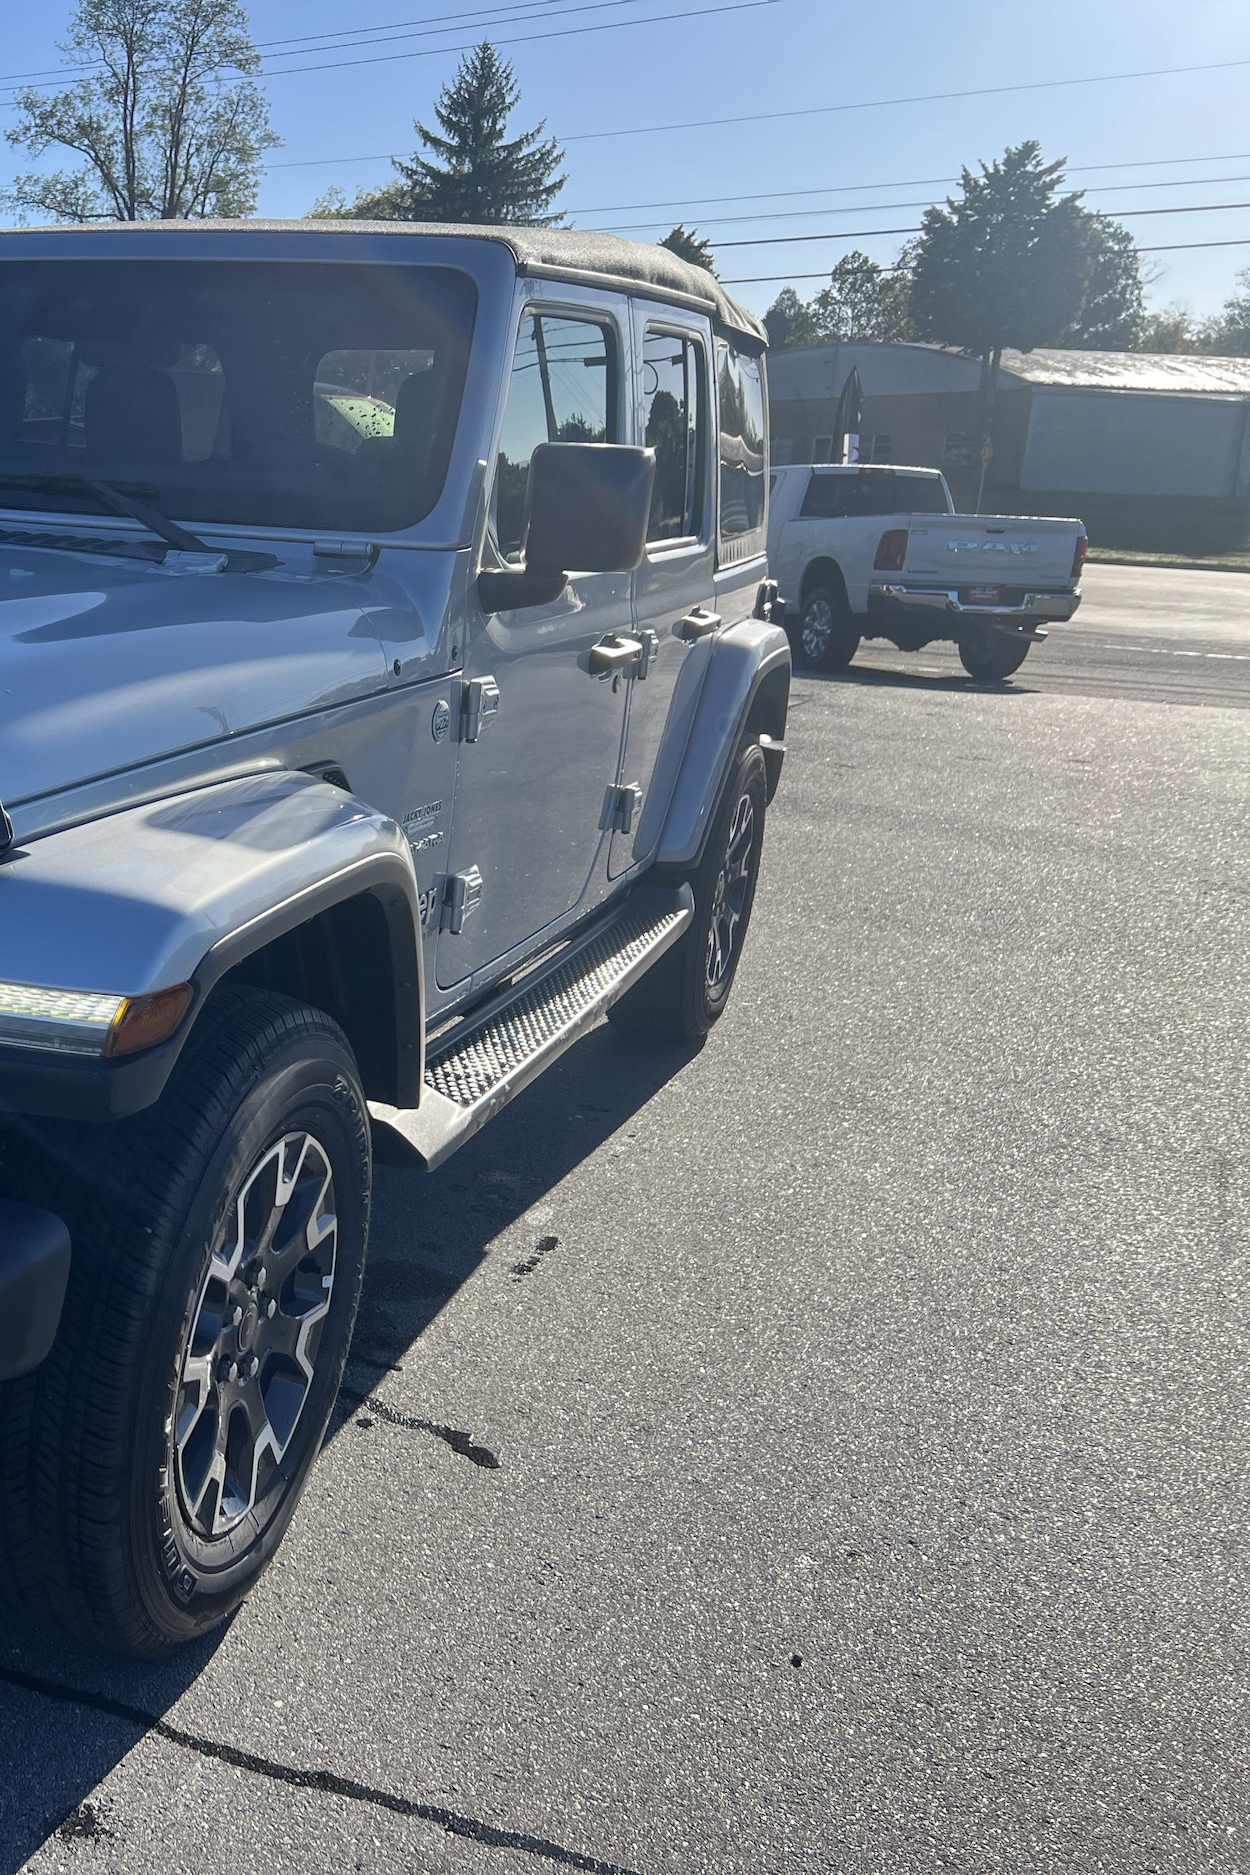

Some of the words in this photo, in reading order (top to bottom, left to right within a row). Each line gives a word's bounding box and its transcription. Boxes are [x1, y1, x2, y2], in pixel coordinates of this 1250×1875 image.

[948, 540, 1039, 555] RAM
[402, 809, 422, 825] JACKY
[423, 801, 443, 817] JONES
